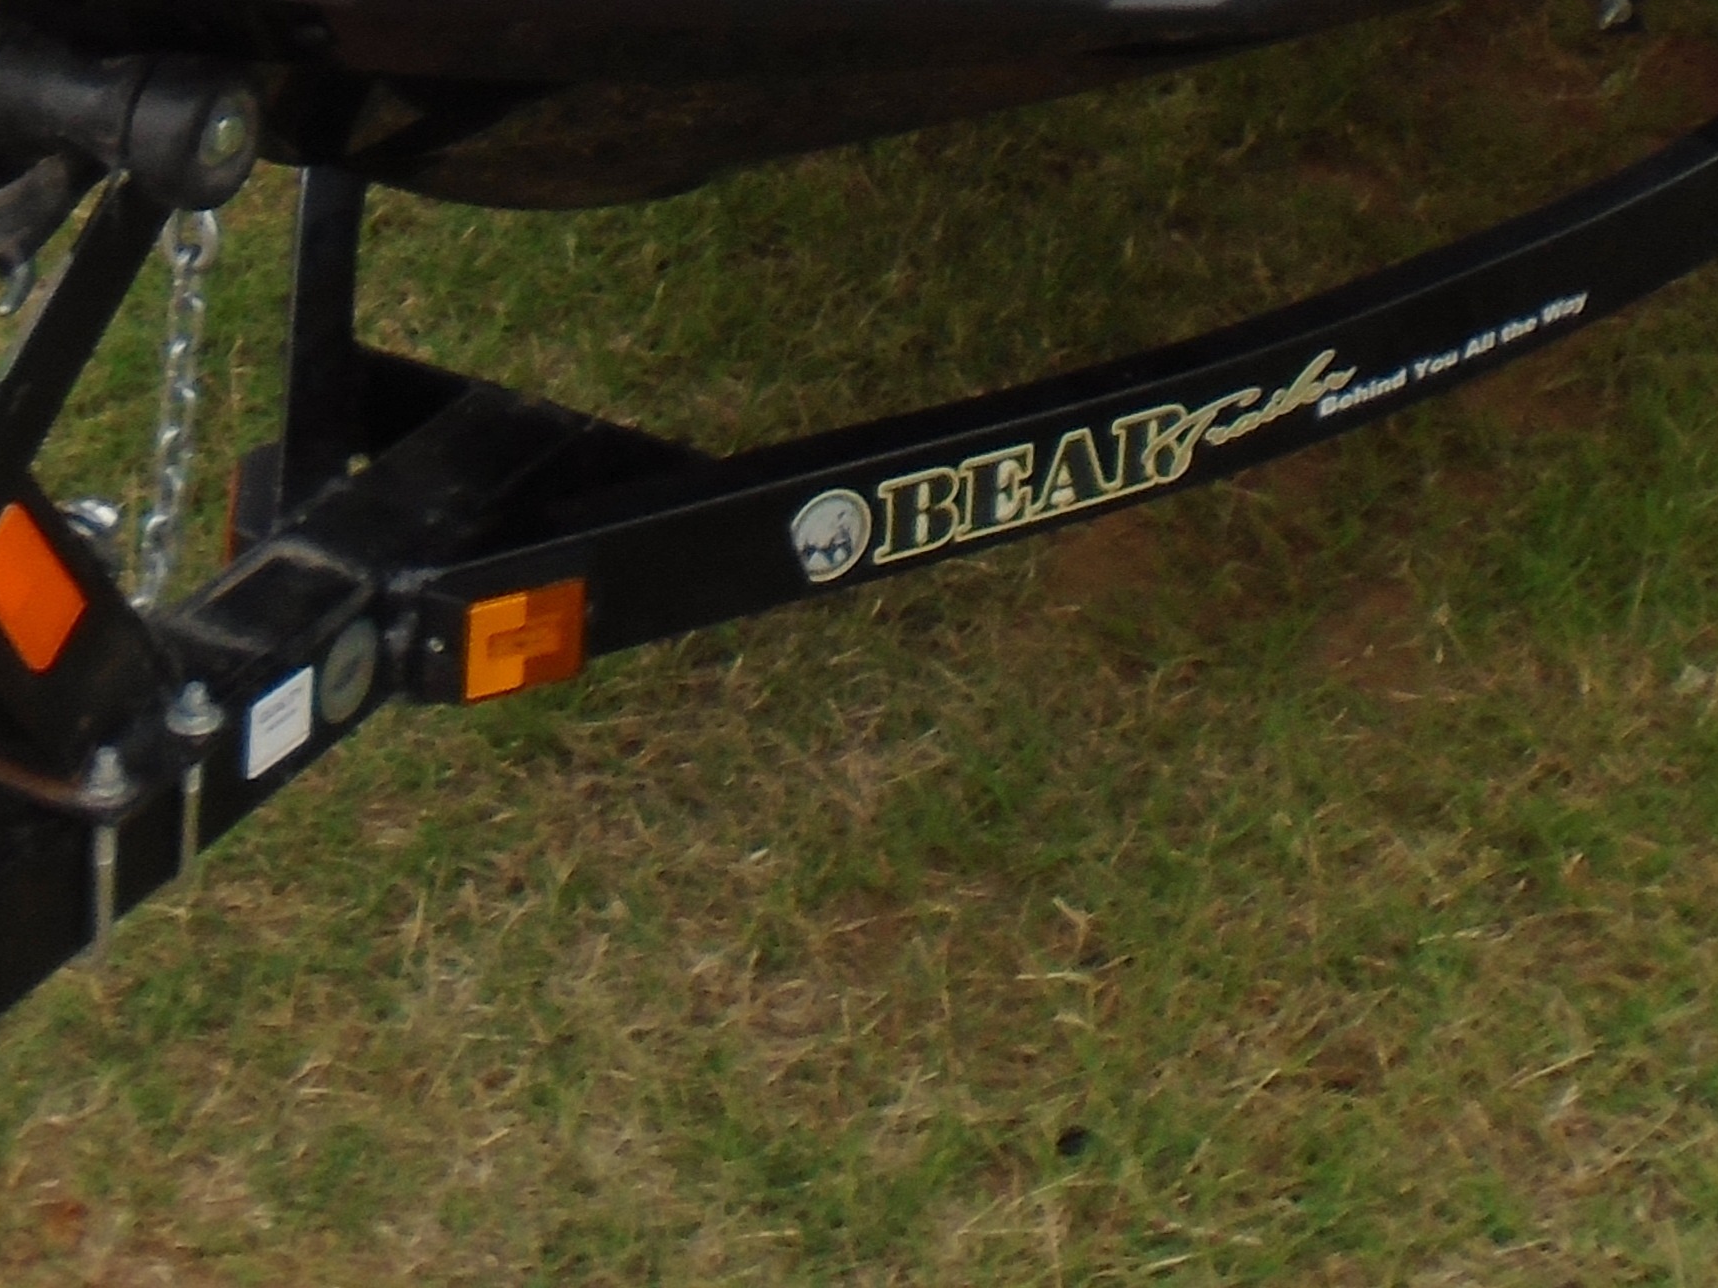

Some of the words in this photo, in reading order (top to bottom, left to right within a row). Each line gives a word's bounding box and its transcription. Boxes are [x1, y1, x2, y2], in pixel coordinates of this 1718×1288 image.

[1316, 367, 1408, 419] Behind
[1413, 349, 1460, 381] You
[1463, 330, 1496, 360] All
[1500, 314, 1538, 343] the
[1541, 291, 1589, 325] Way
[872, 403, 1191, 566] BEAR
